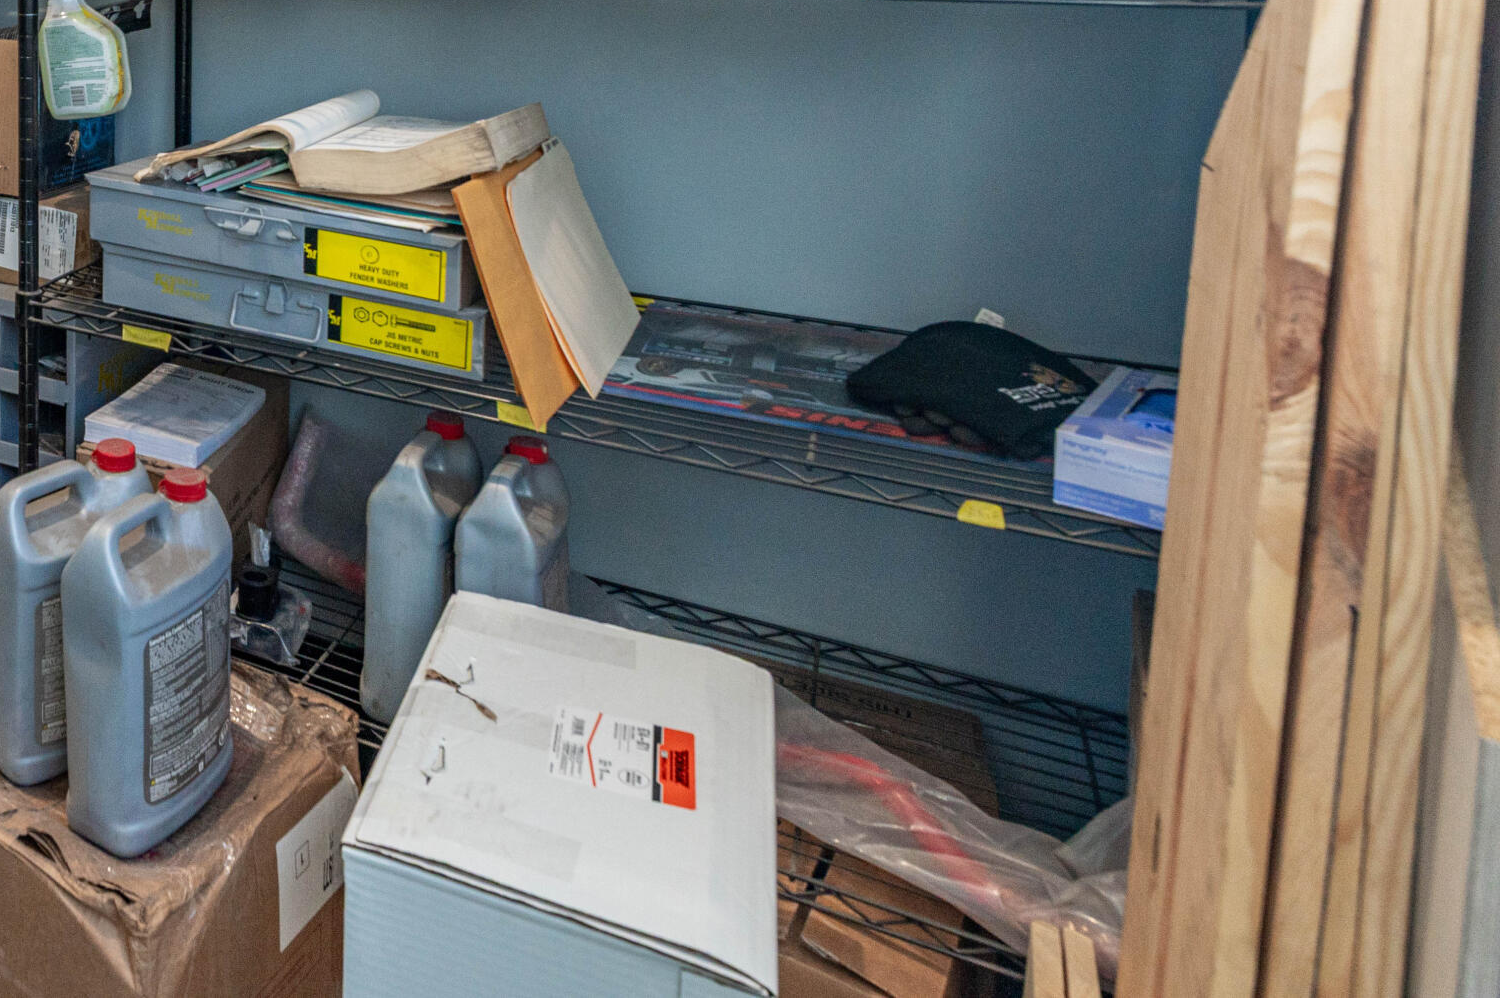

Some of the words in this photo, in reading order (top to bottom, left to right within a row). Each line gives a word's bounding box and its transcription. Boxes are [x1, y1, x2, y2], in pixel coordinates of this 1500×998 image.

[359, 264, 380, 275] HEAVY
[382, 267, 400, 277] DUTY
[350, 272, 375, 283] FENDER
[376, 277, 409, 290] WASHERS
[398, 333, 423, 345] METRIC
[369, 337, 382, 346] CAP
[384, 340, 412, 352] SCREWS
[421, 348, 440, 359] NUTS
